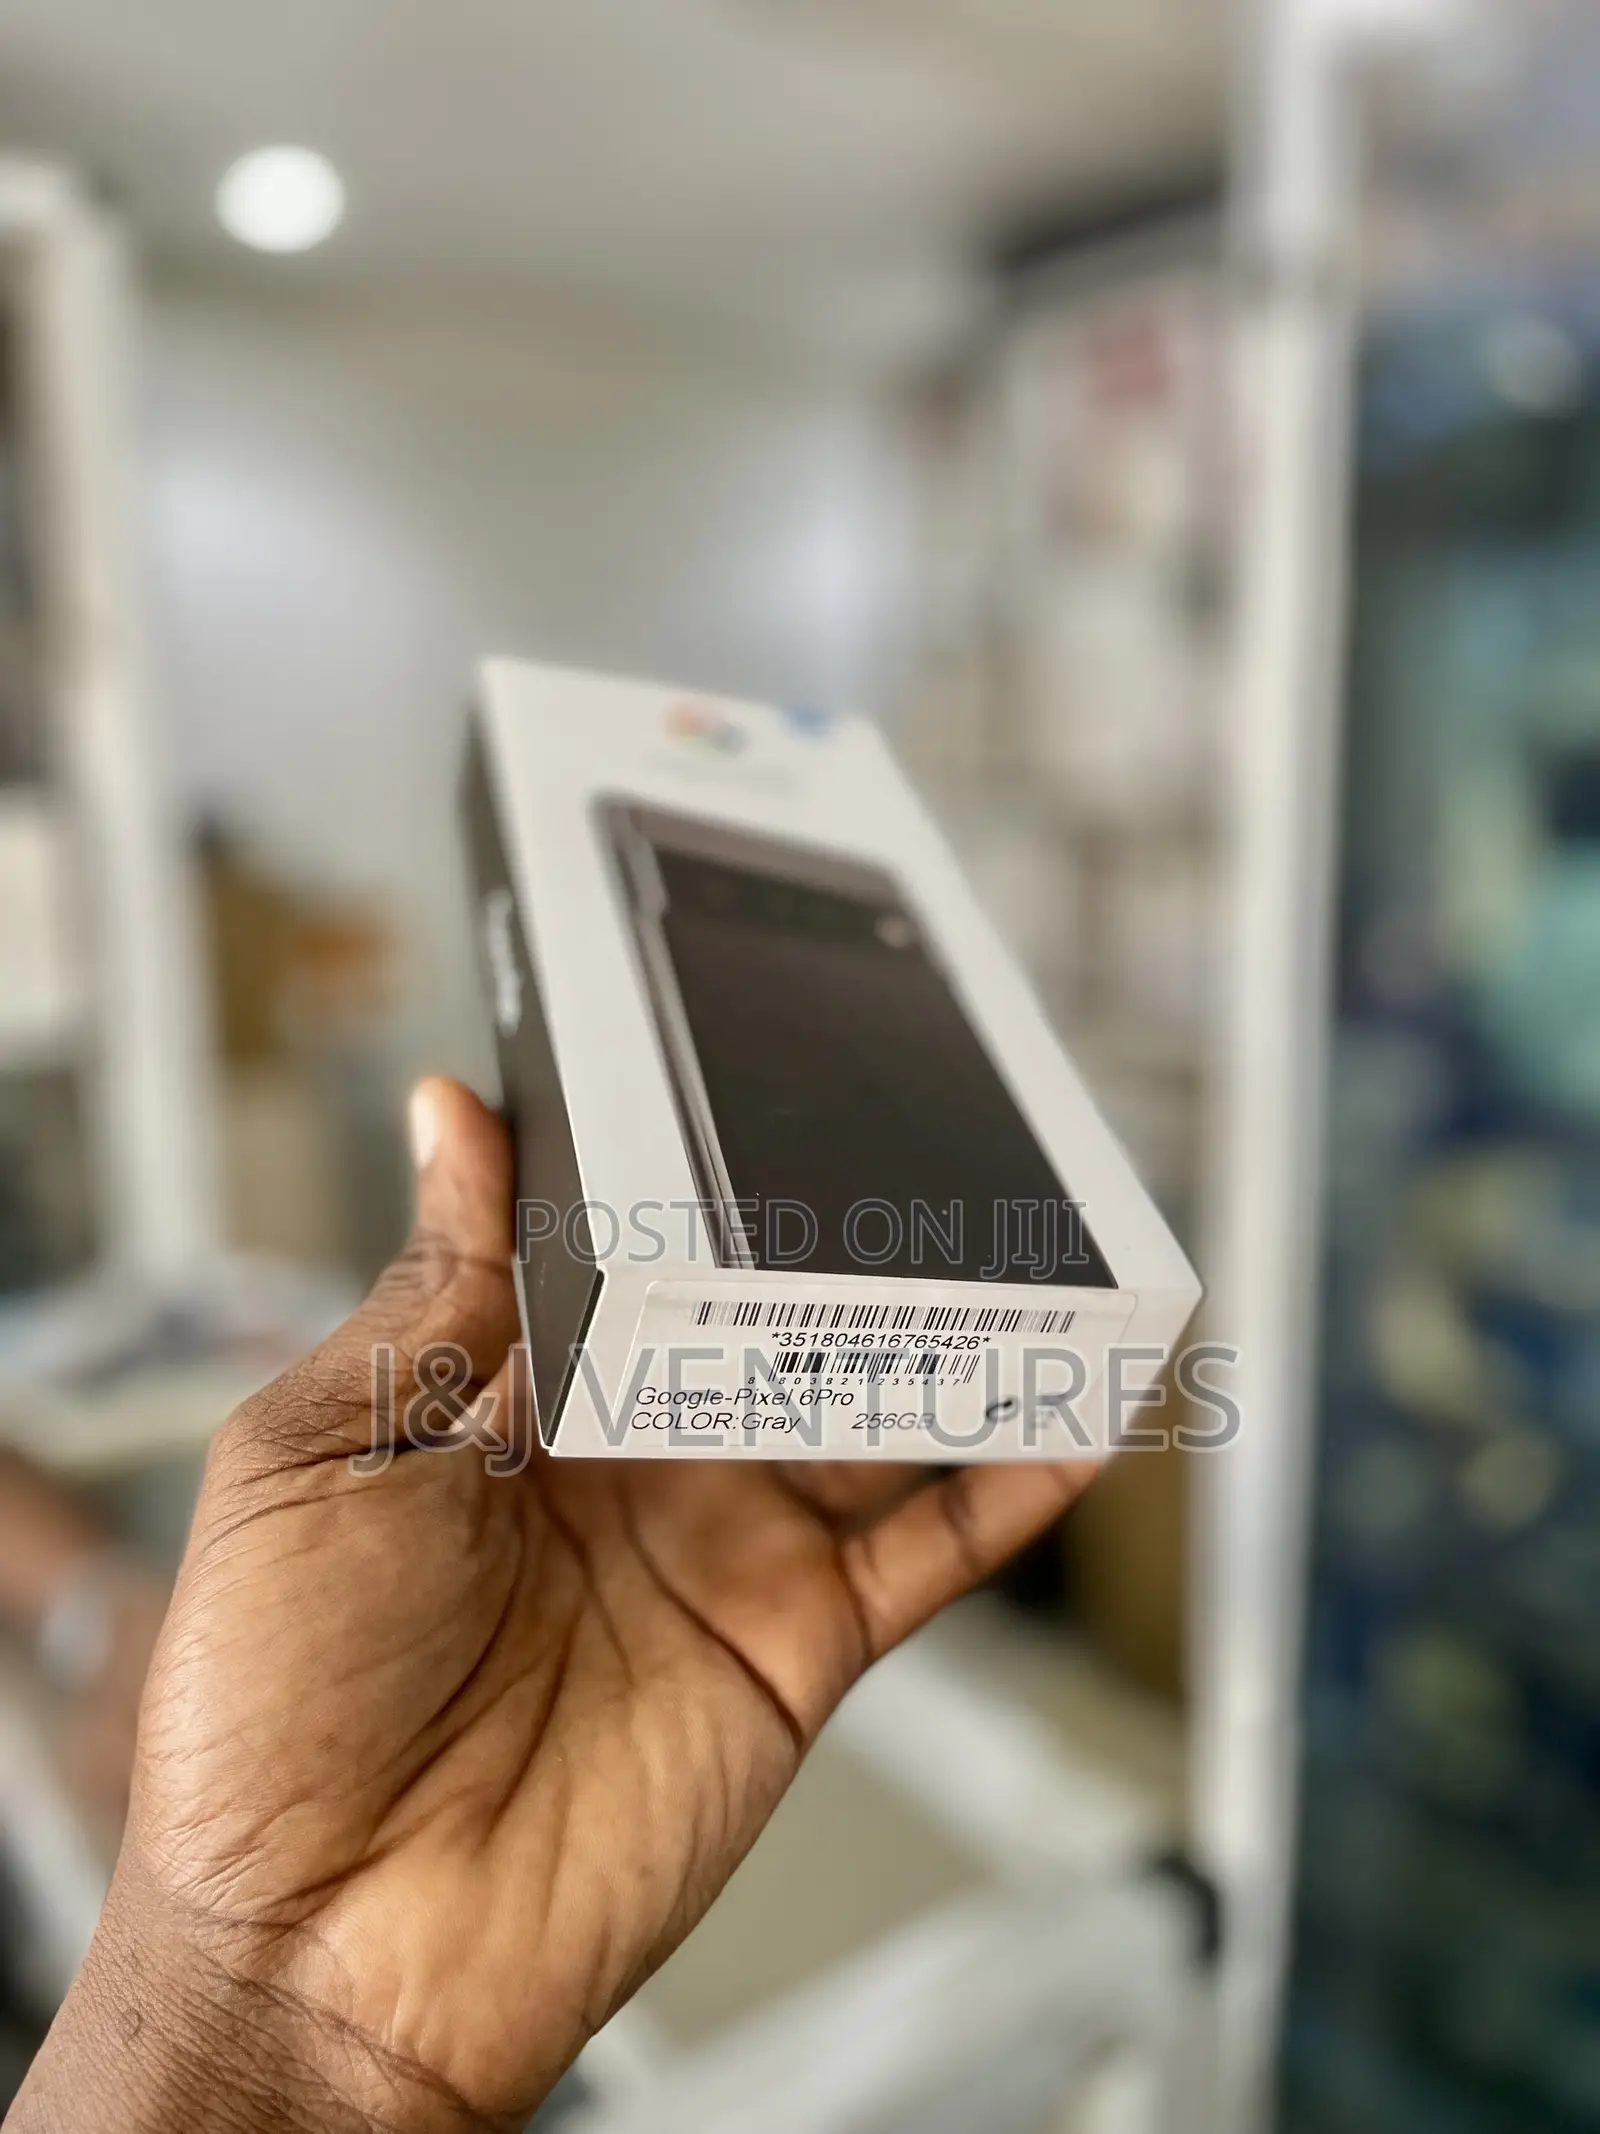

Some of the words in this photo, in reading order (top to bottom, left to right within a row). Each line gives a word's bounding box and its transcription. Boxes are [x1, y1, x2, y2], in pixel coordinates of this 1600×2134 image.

[636, 1386, 793, 1409] Google-Pixel
[800, 1388, 855, 1407] 6Pro
[851, 1413, 936, 1430] 256GB
